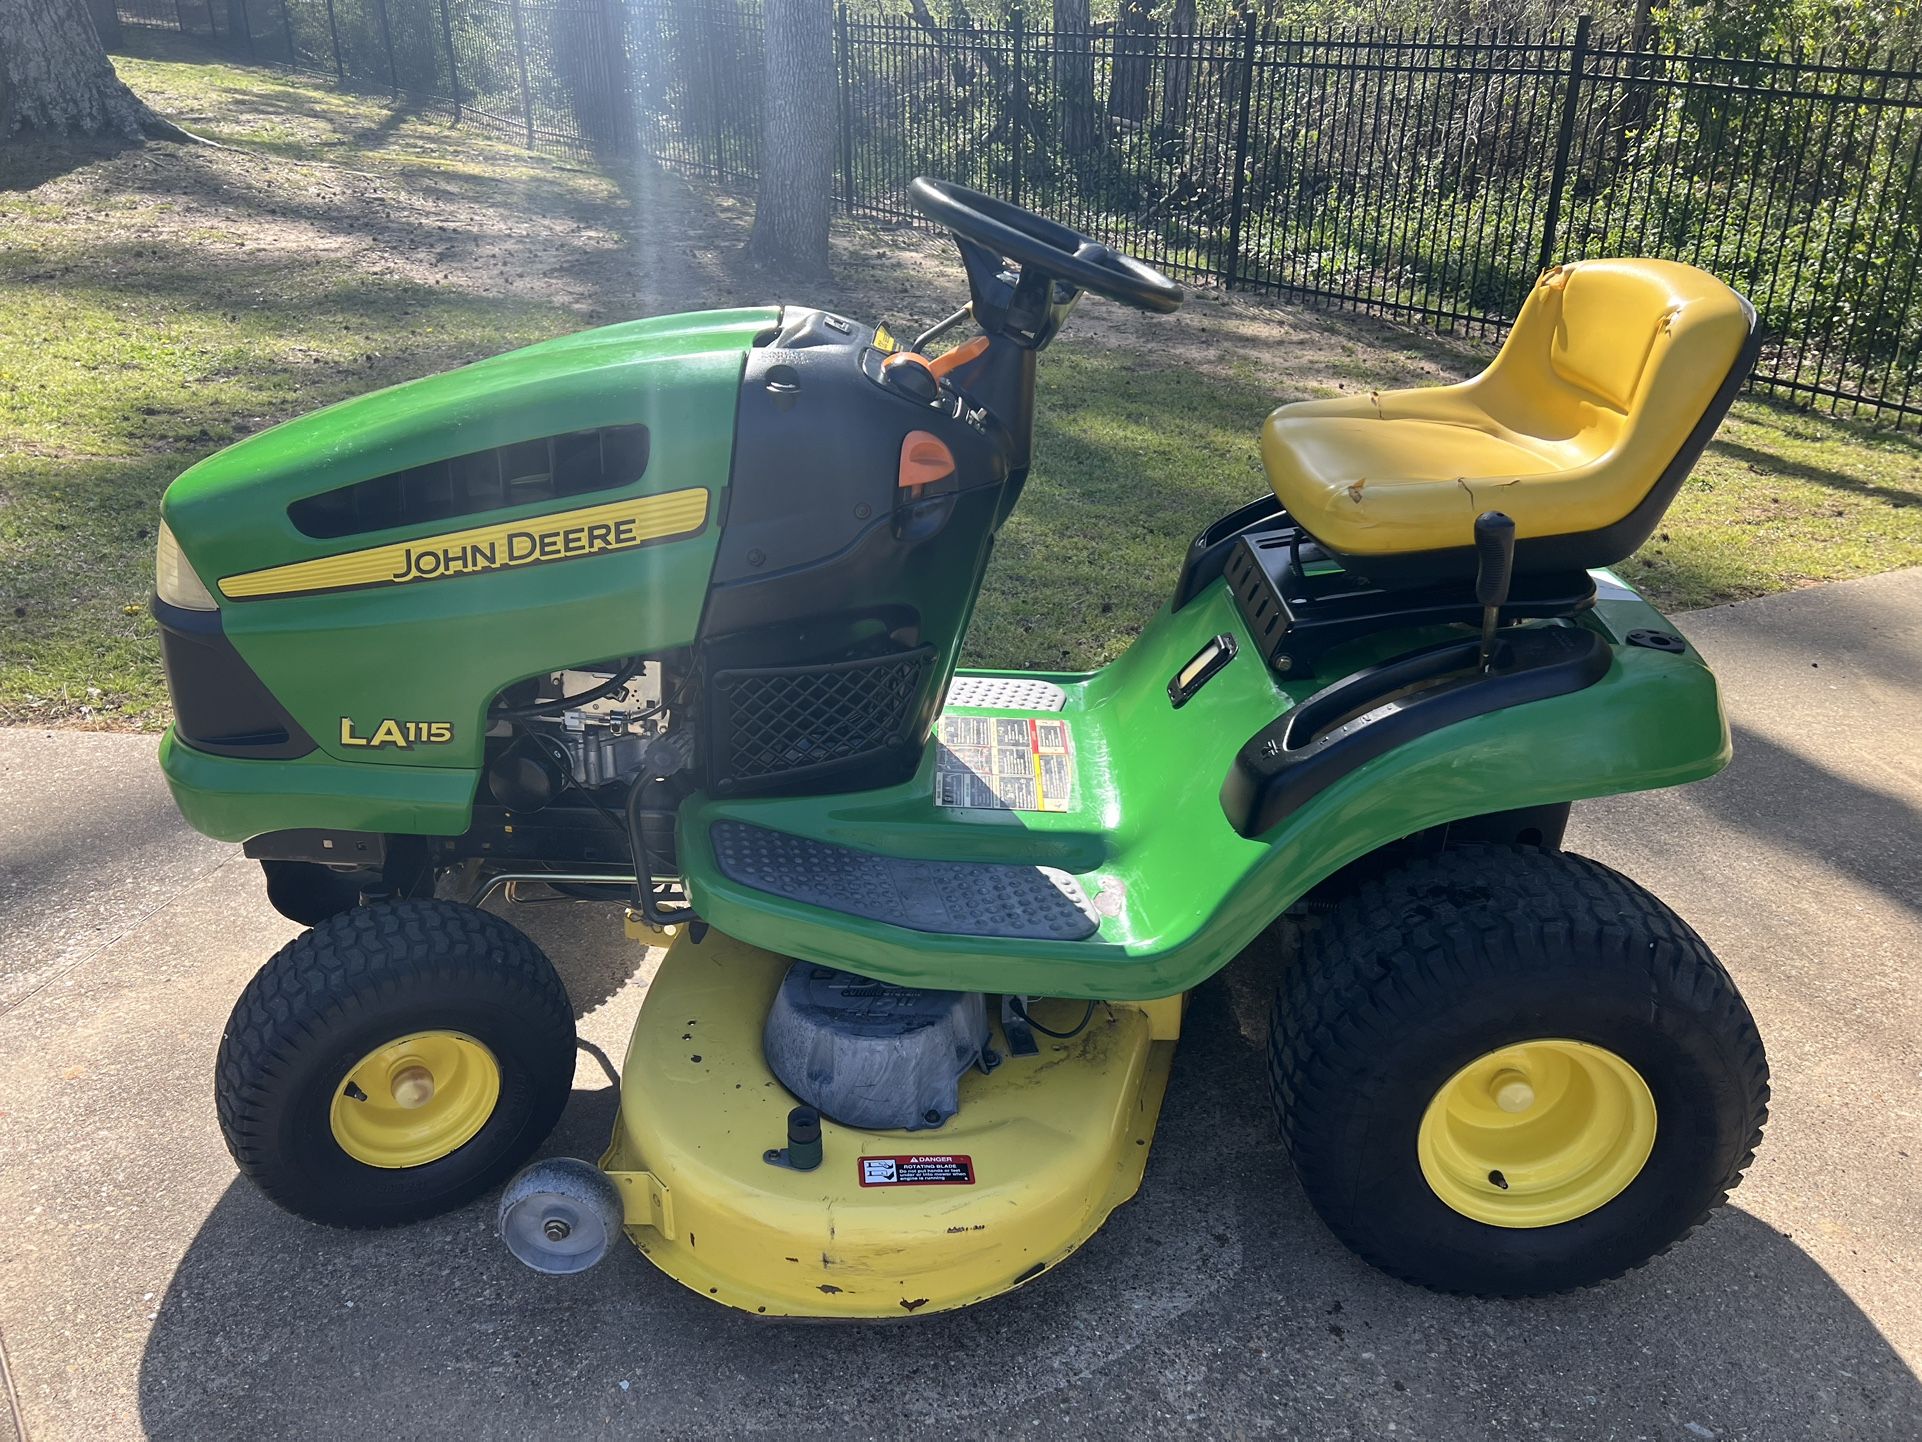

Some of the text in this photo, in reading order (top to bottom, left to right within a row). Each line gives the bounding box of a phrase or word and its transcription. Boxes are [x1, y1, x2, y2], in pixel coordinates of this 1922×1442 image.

[392, 518, 638, 580] JOHN DEERE
[340, 716, 454, 749] LA115
